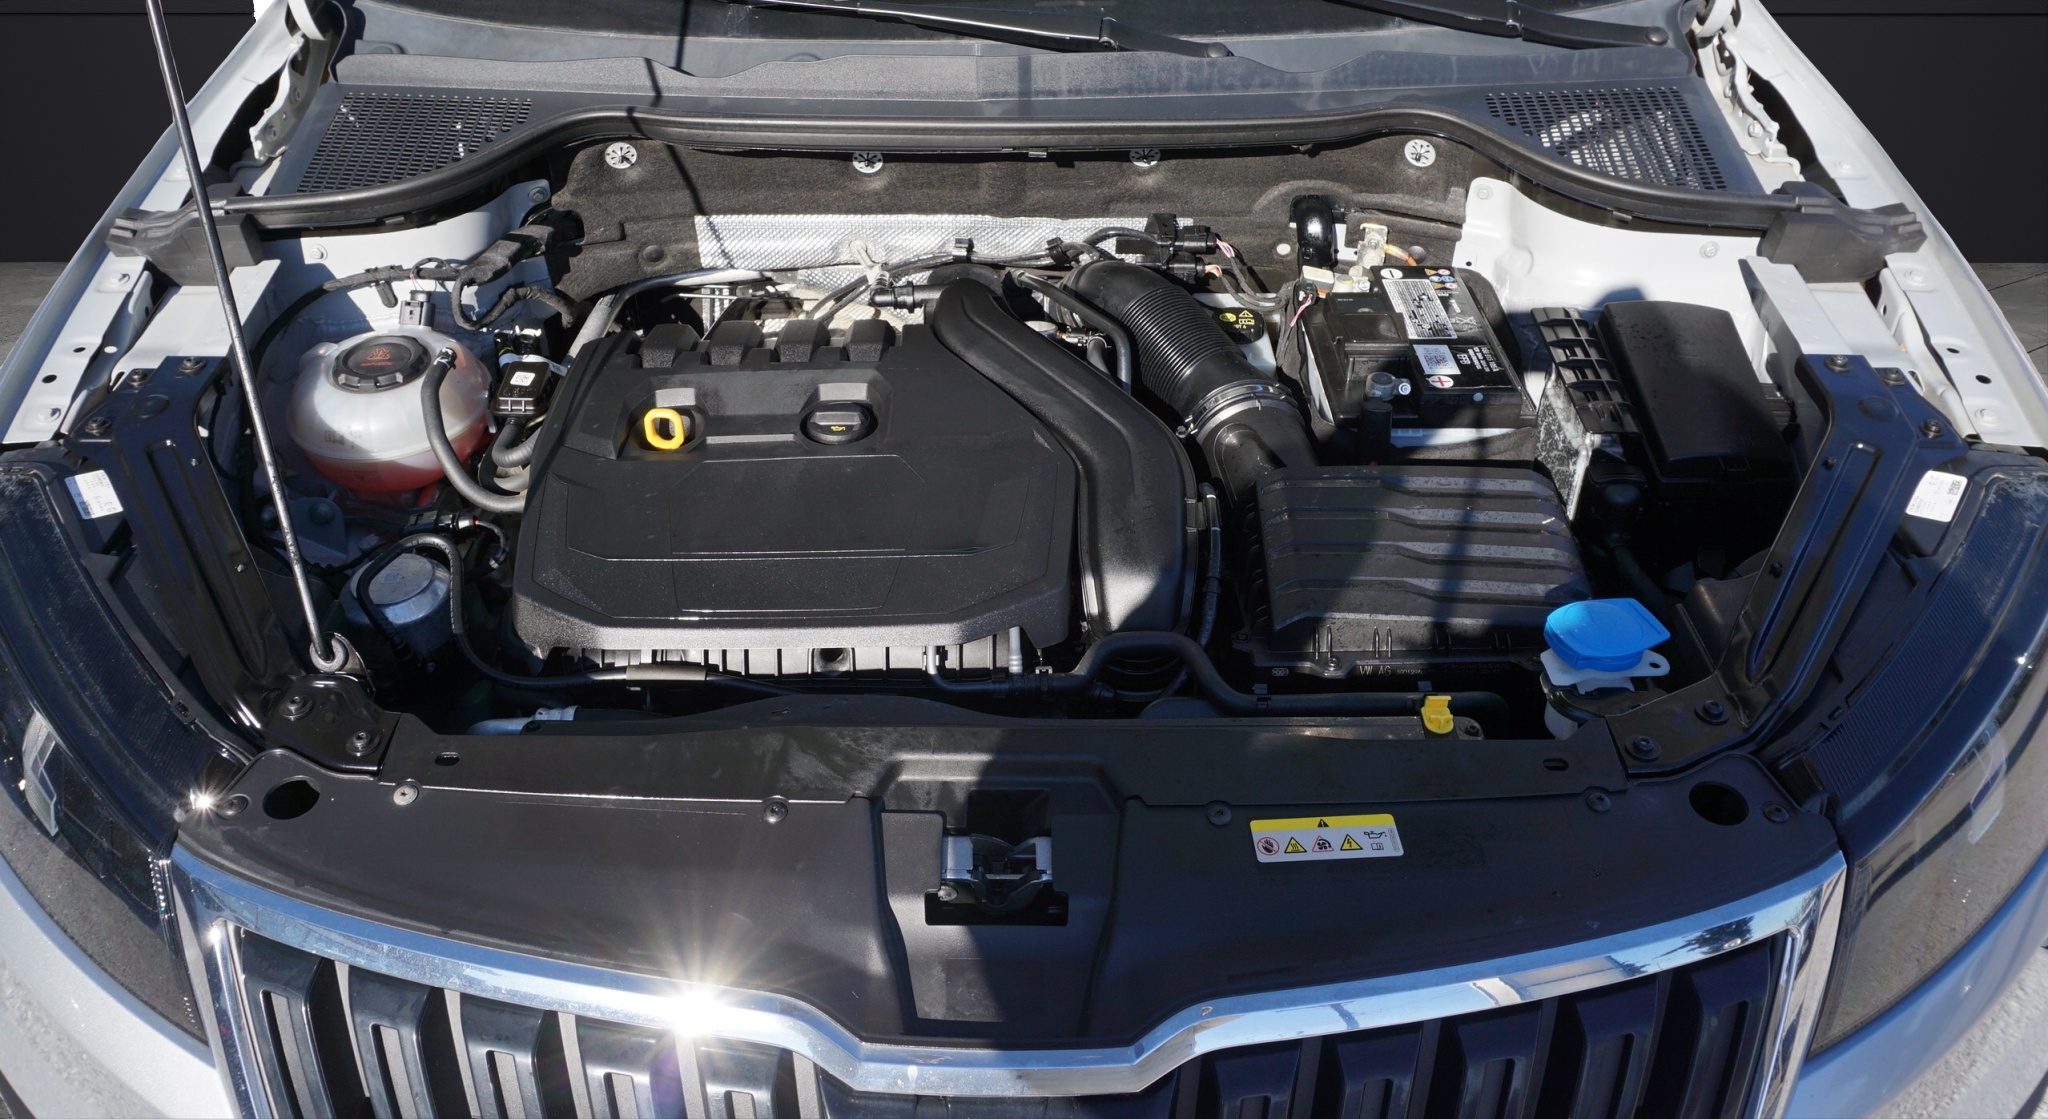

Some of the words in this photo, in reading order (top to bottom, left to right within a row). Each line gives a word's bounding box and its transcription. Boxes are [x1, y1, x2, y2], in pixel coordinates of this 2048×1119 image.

[1457, 353, 1471, 365] EFB
[1359, 665, 1373, 676] VW
[1378, 665, 1392, 677] AG
